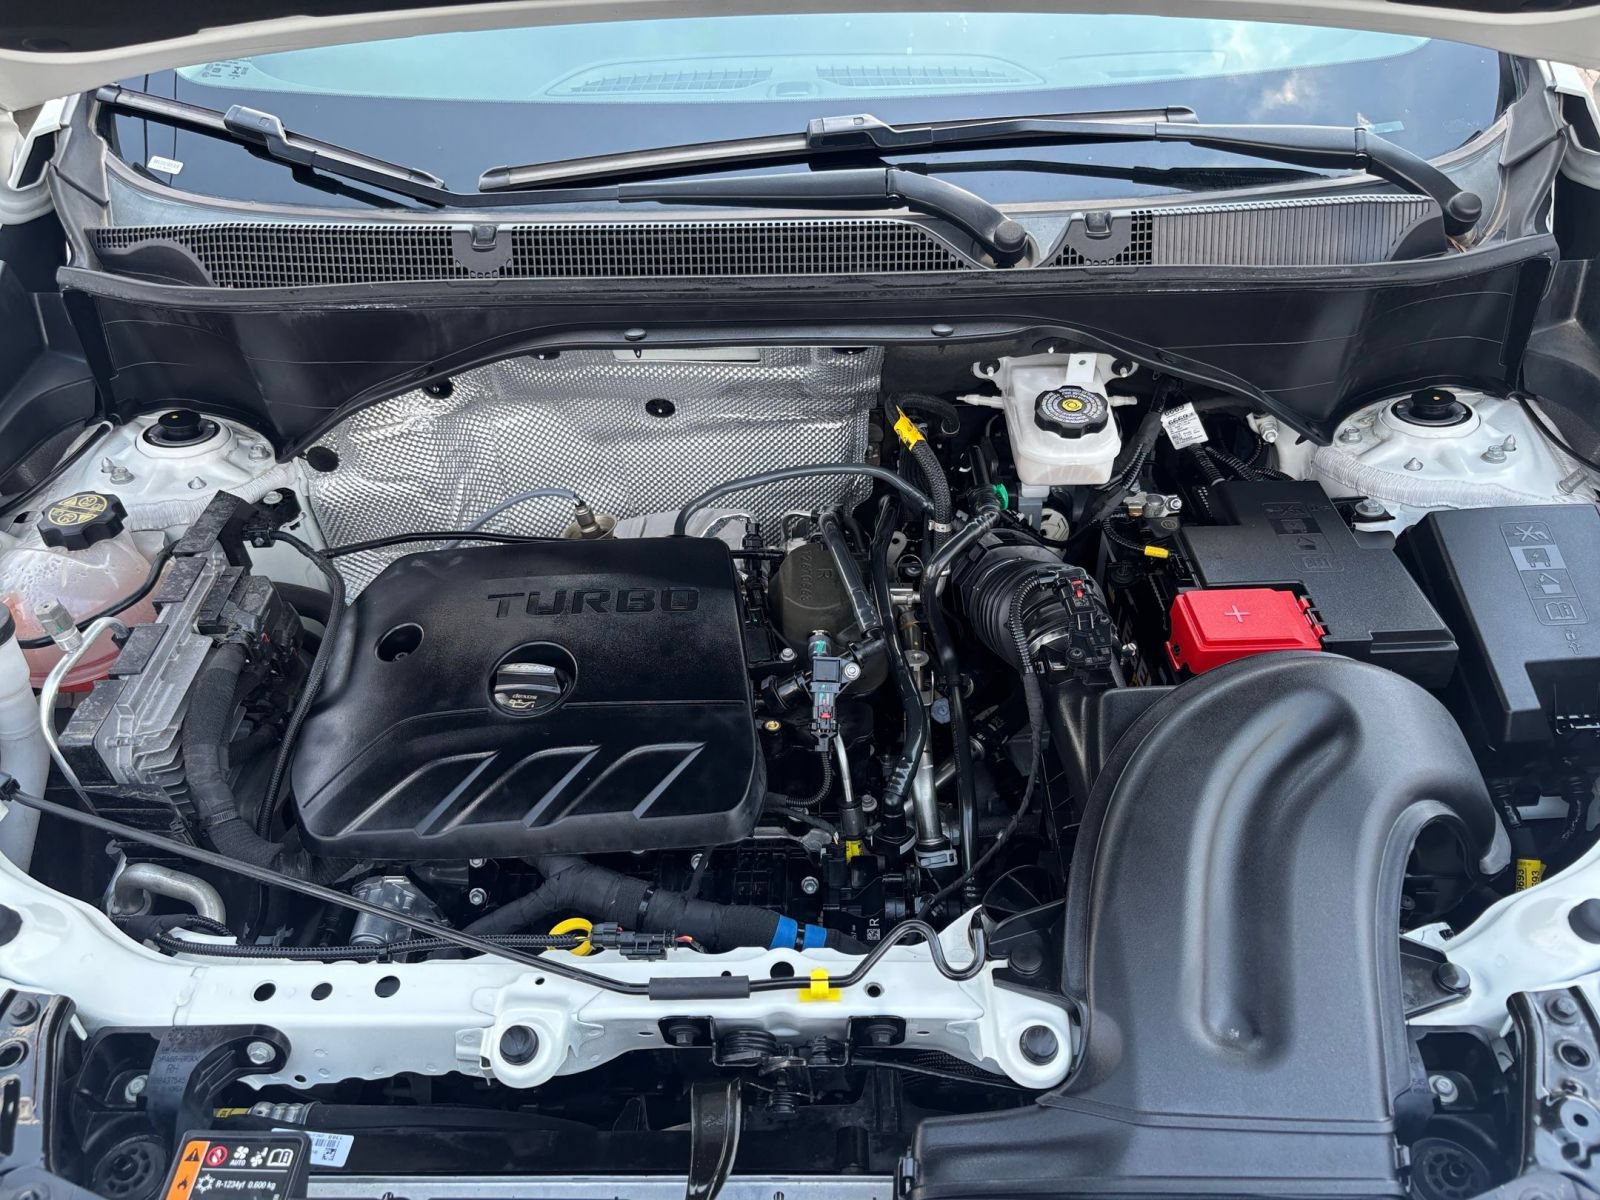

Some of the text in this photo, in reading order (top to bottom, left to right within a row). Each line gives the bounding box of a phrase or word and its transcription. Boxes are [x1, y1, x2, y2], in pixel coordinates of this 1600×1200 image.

[487, 587, 699, 618] TURBO
[869, 918, 880, 927] R
[229, 1159, 247, 1167] AUTO
[215, 1180, 277, 1191] R-1234yf 0.600 kg
